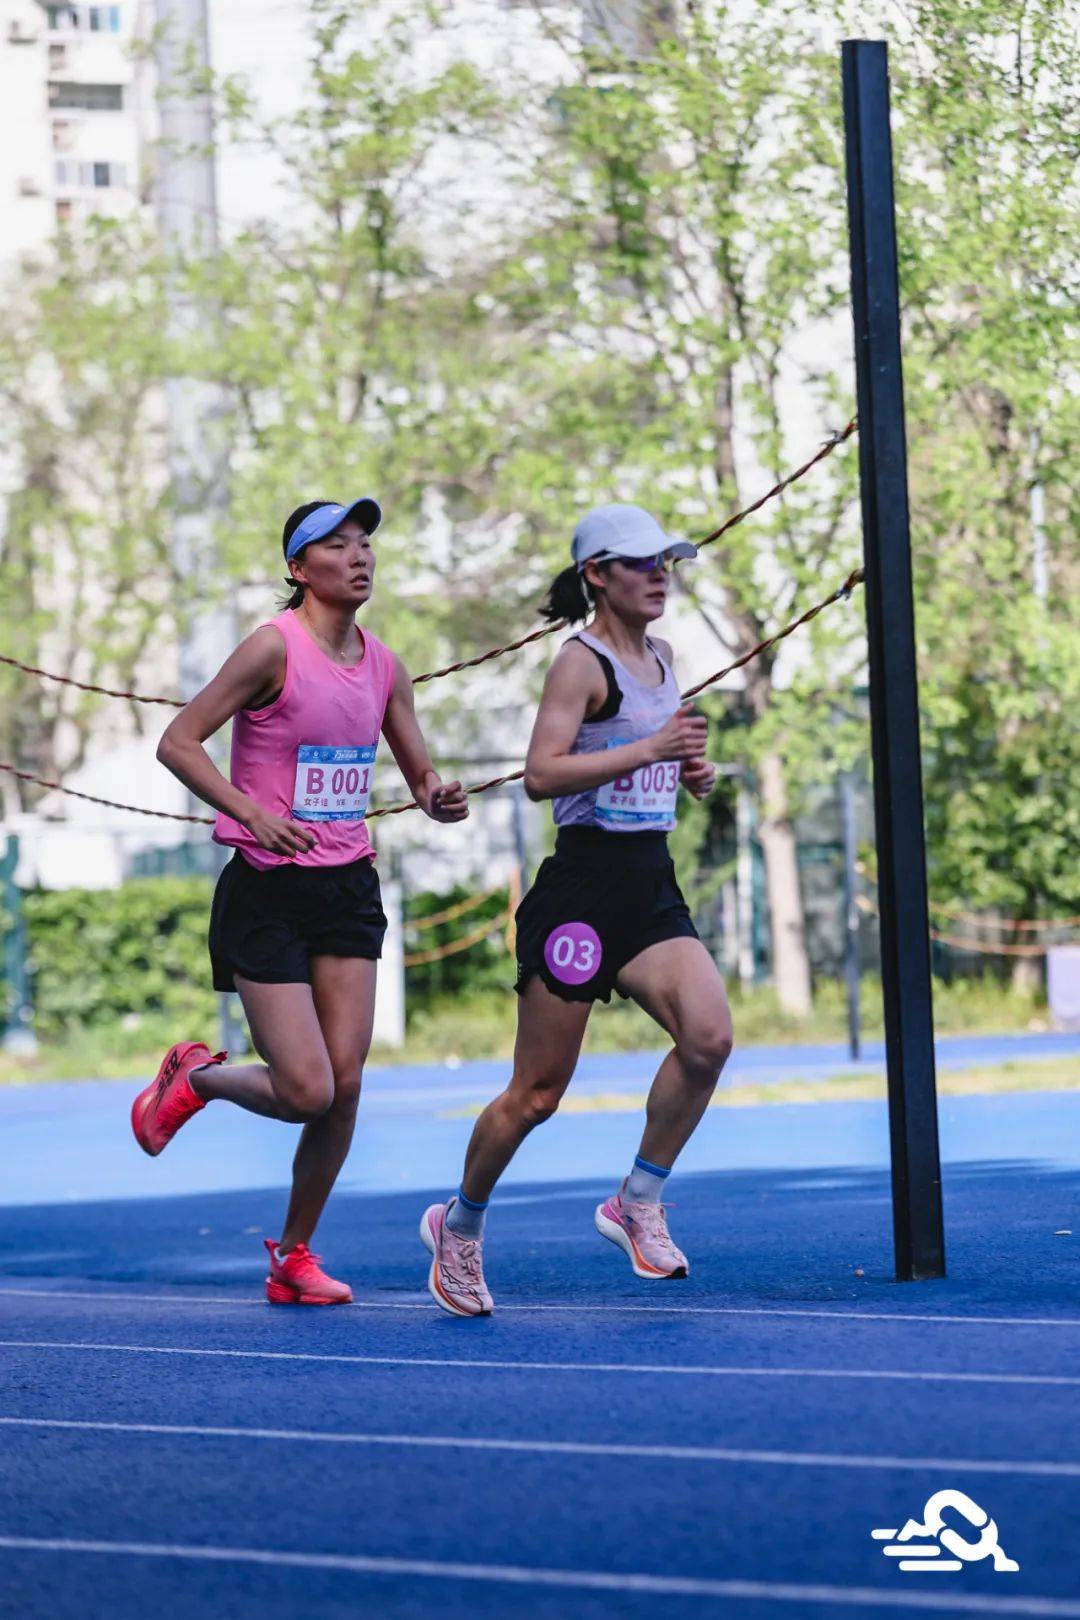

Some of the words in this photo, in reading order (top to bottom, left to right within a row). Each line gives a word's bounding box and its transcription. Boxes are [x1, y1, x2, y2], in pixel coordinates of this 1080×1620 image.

[306, 768, 324, 794] B
[332, 768, 369, 795] 001
[641, 764, 677, 794] 003
[552, 935, 595, 971] 03
